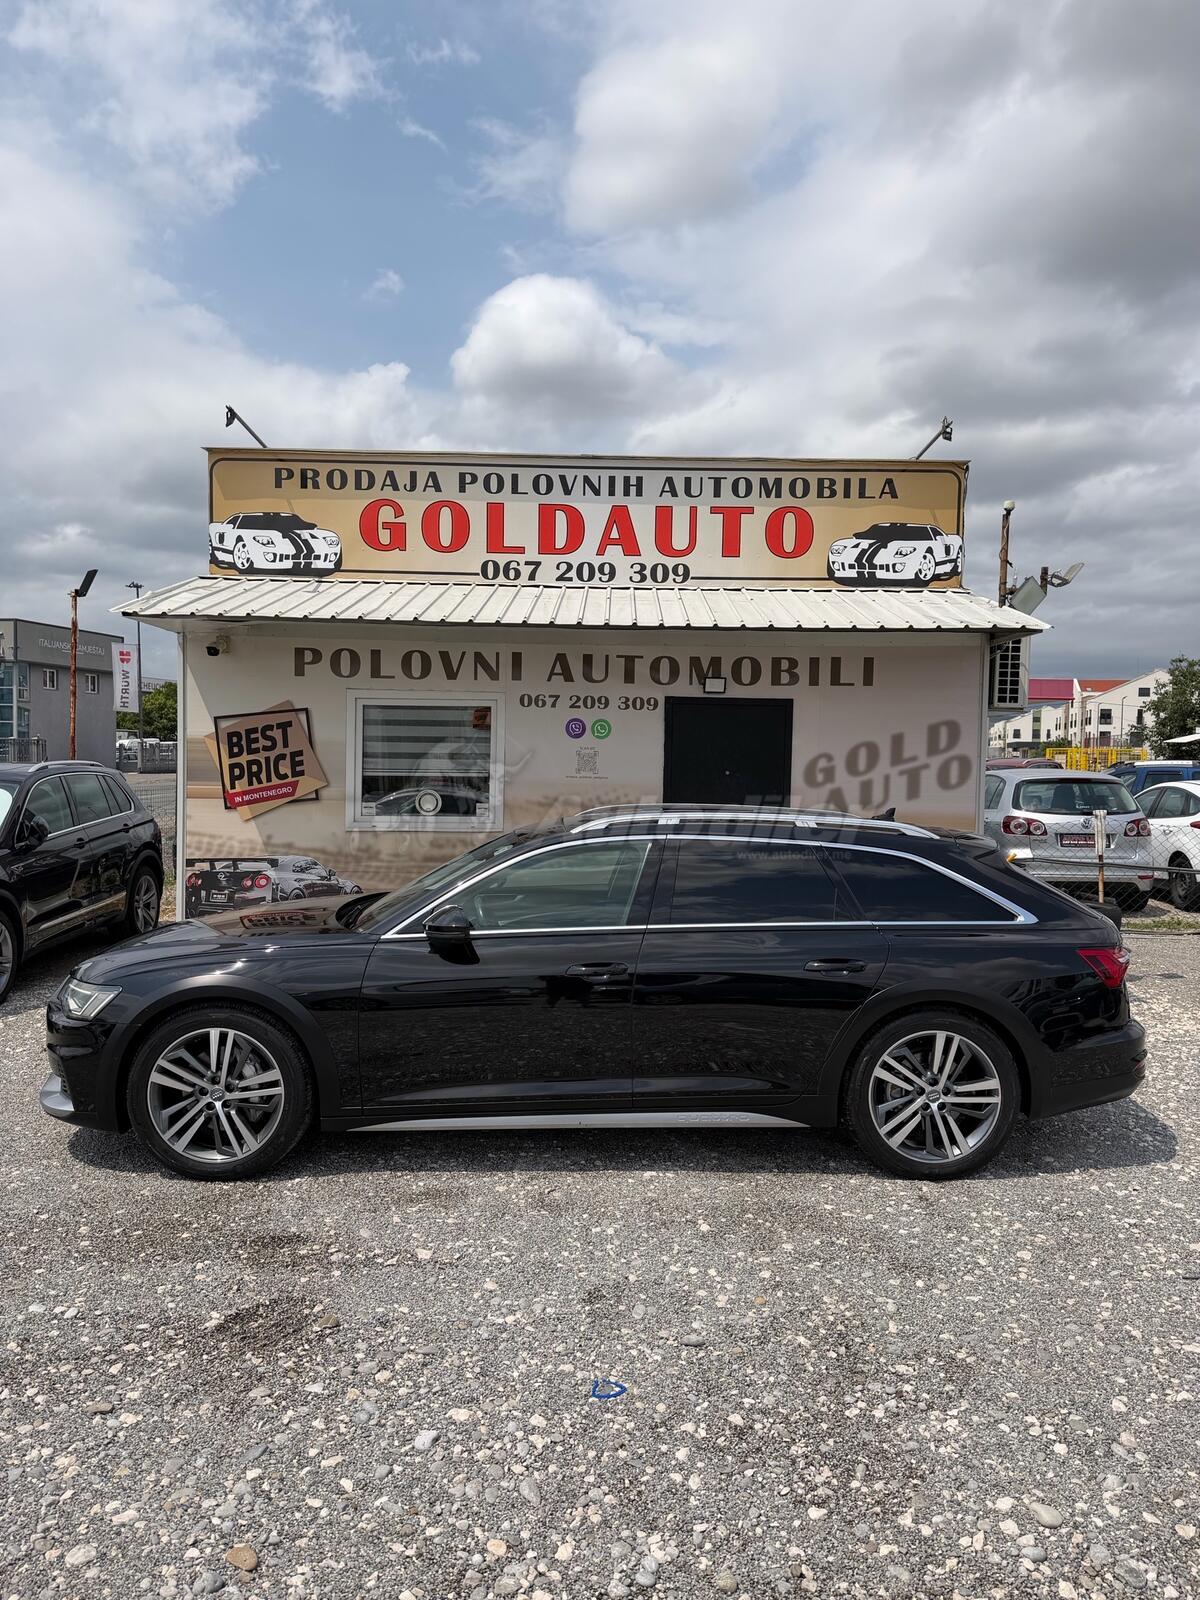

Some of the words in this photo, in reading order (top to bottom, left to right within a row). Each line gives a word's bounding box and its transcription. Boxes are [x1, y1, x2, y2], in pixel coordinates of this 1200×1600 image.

[274, 467, 443, 493] PRODAJA
[458, 471, 644, 498] POLOVNIH
[658, 475, 899, 500] AUTOMOBILA
[358, 498, 815, 560] GOLDAUTO
[479, 560, 542, 582] 067
[555, 561, 616, 583] 209
[629, 562, 692, 584] 309
[293, 647, 522, 682] POLOVNI
[546, 651, 876, 687] AUTOMOBILI
[519, 693, 560, 709] 067
[568, 695, 609, 710] 209
[617, 696, 659, 711] 309
[226, 720, 293, 759] BEST
[803, 719, 962, 789] GOLD
[228, 749, 305, 790] PRICE
[824, 753, 972, 813] AUTO
[243, 786, 293, 801] MONTENEGRO
